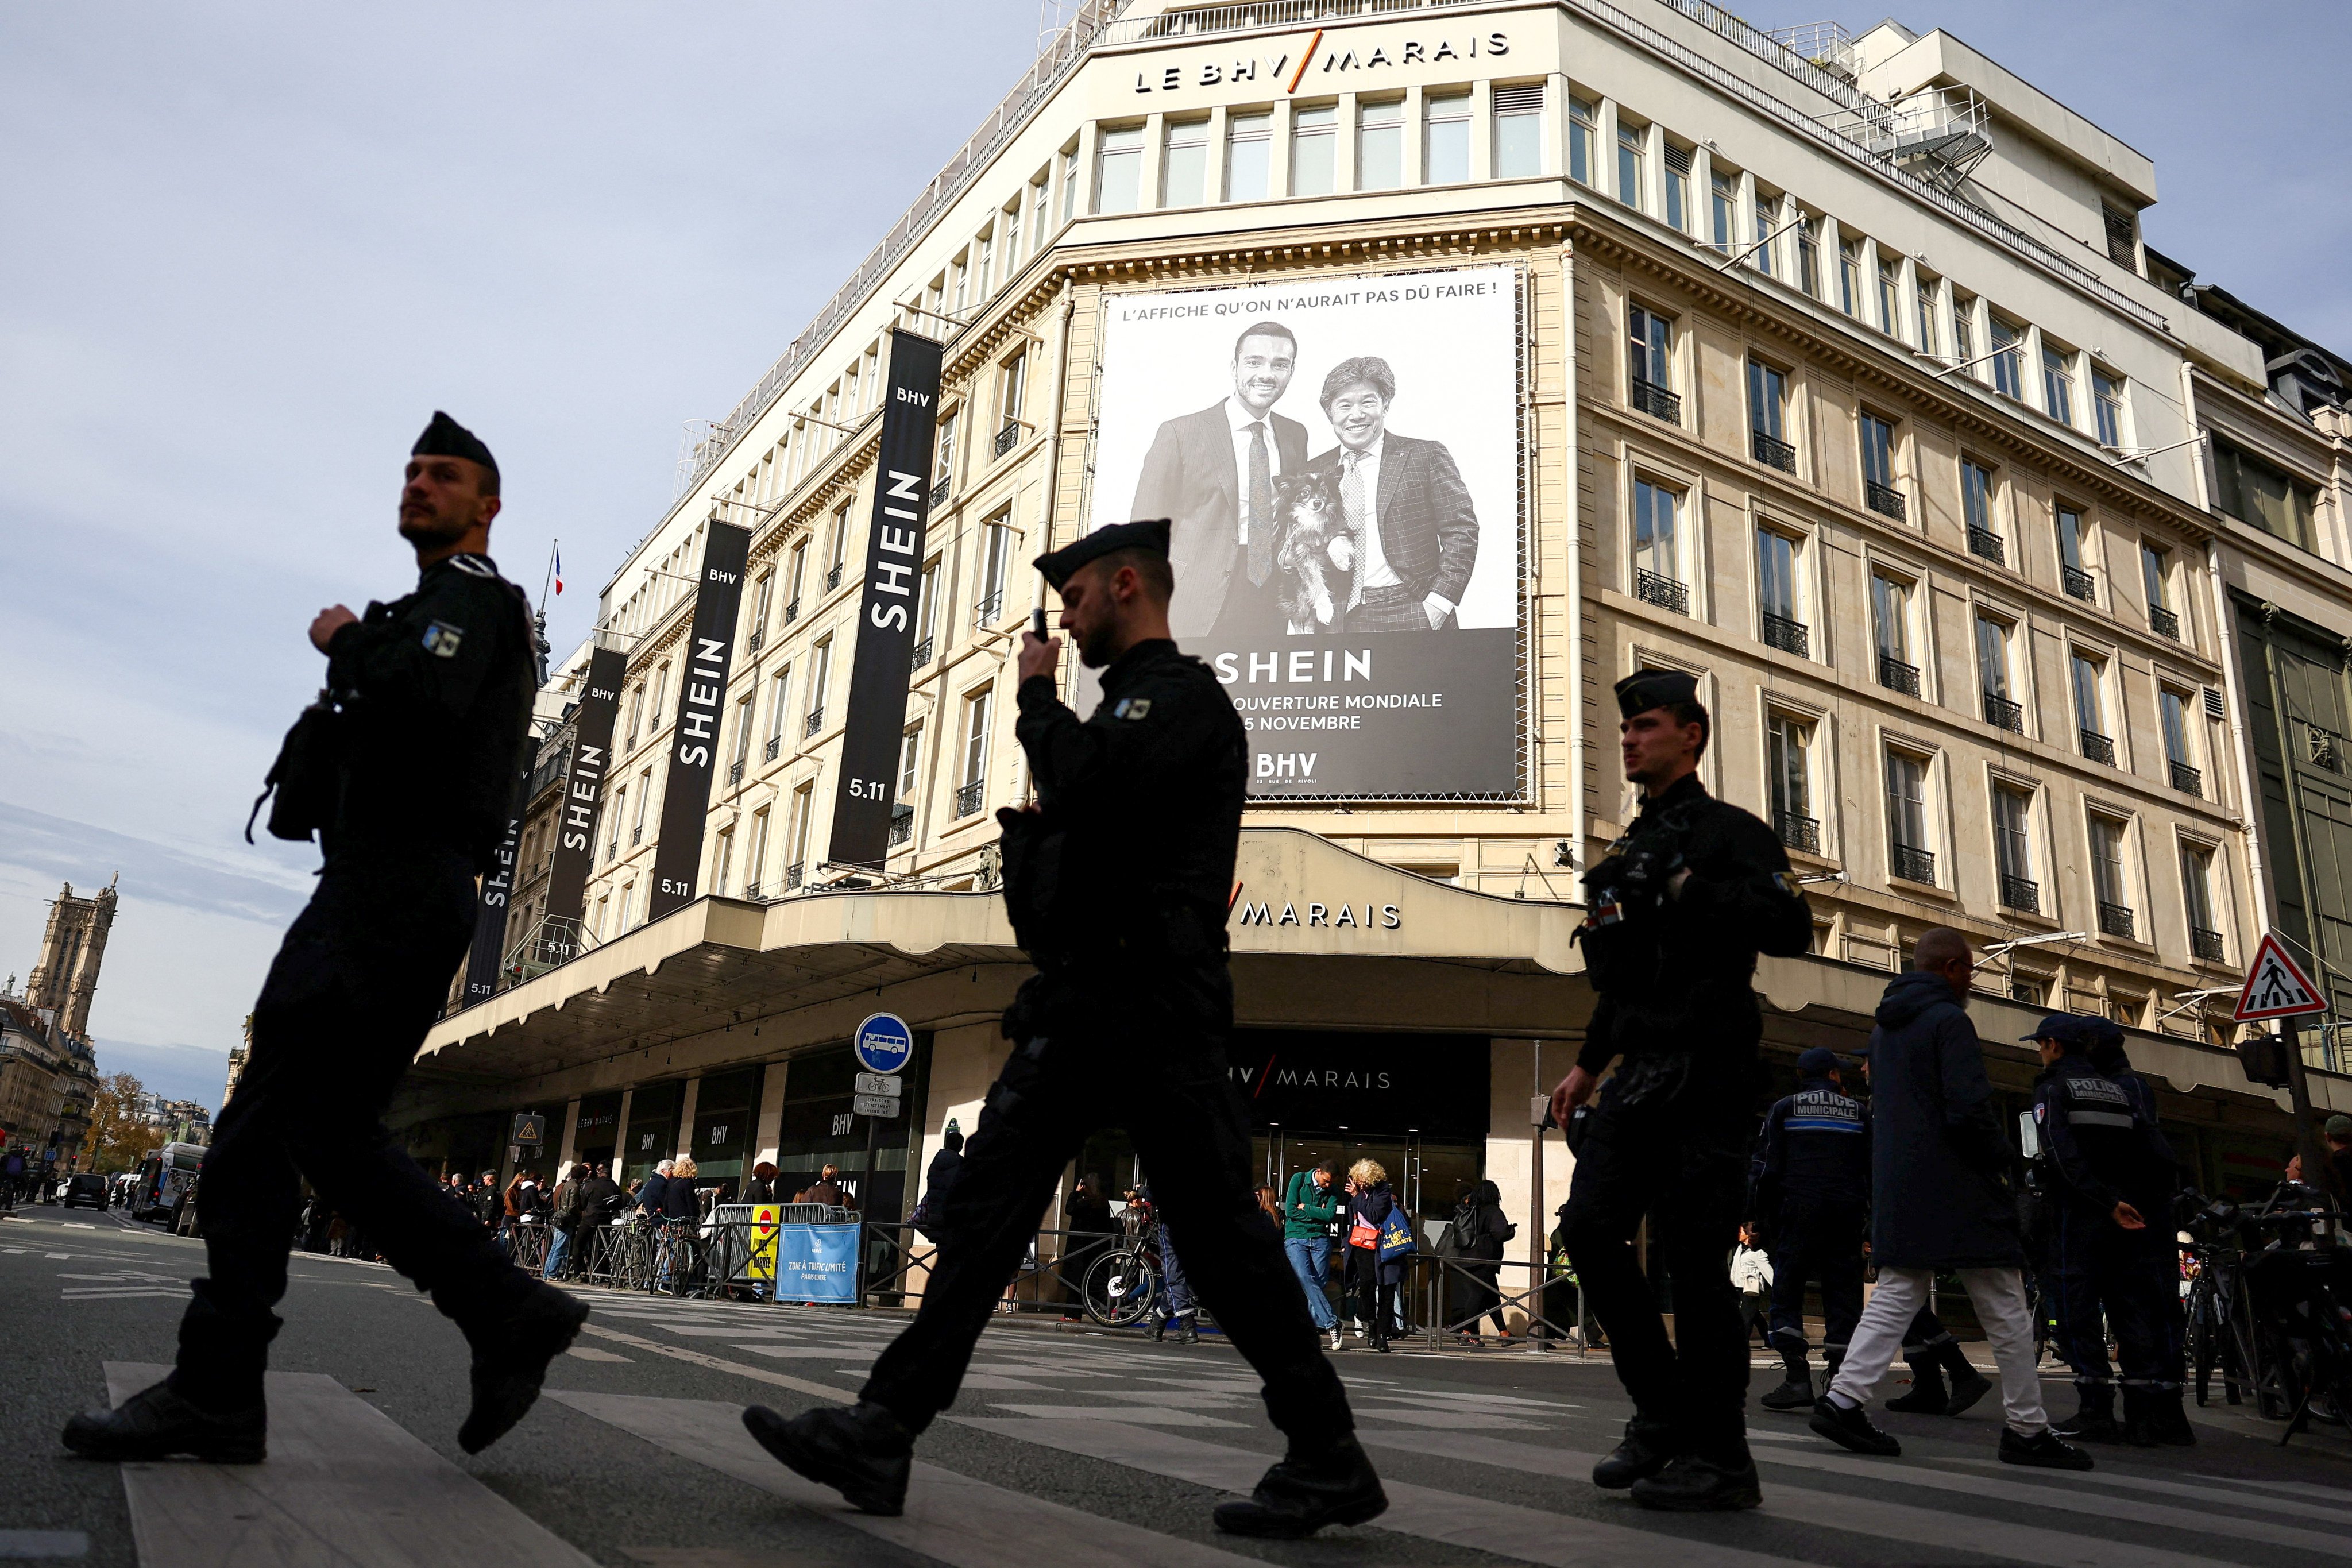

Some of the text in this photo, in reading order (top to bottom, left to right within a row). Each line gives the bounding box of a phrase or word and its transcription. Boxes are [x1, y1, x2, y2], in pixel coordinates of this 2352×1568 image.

[1135, 67, 1180, 93] LE
[1123, 305, 1209, 322] L’AFFICHE
[1215, 300, 1271, 316] QU’ON
[1277, 293, 1360, 310] N’AURAIT
[1366, 290, 1399, 303] PAS
[1405, 284, 1430, 300] DÛ
[1436, 283, 1486, 298] FAIRE
[896, 387, 930, 408] BHV
[870, 469, 922, 634] SHEIN
[709, 569, 737, 585] BHV
[1214, 648, 1372, 684] SHEIN
[591, 688, 615, 702] BHV
[680, 638, 726, 768] SHEIN
[1233, 693, 1442, 711] OUVERTURE MONDIALE
[1260, 716, 1361, 731] NOVEMBRE
[1256, 752, 1318, 777] BHV
[563, 744, 603, 852] SHEIN
[848, 778, 886, 802] 5.11
[661, 878, 689, 896] 5.11
[470, 983, 491, 995] 5.11
[2069, 1080, 2122, 1095] POLICE
[2075, 1091, 2126, 1102] MUNICIPALE
[1797, 1092, 1855, 1107] POLICE
[1797, 1106, 1855, 1117] MUNICIPALE
[832, 1113, 853, 1136] BHV
[642, 1133, 655, 1150] BHV
[711, 1125, 728, 1145] BHV
[789, 1260, 846, 1272] ZONE À TRAFIC LIMITÉ
